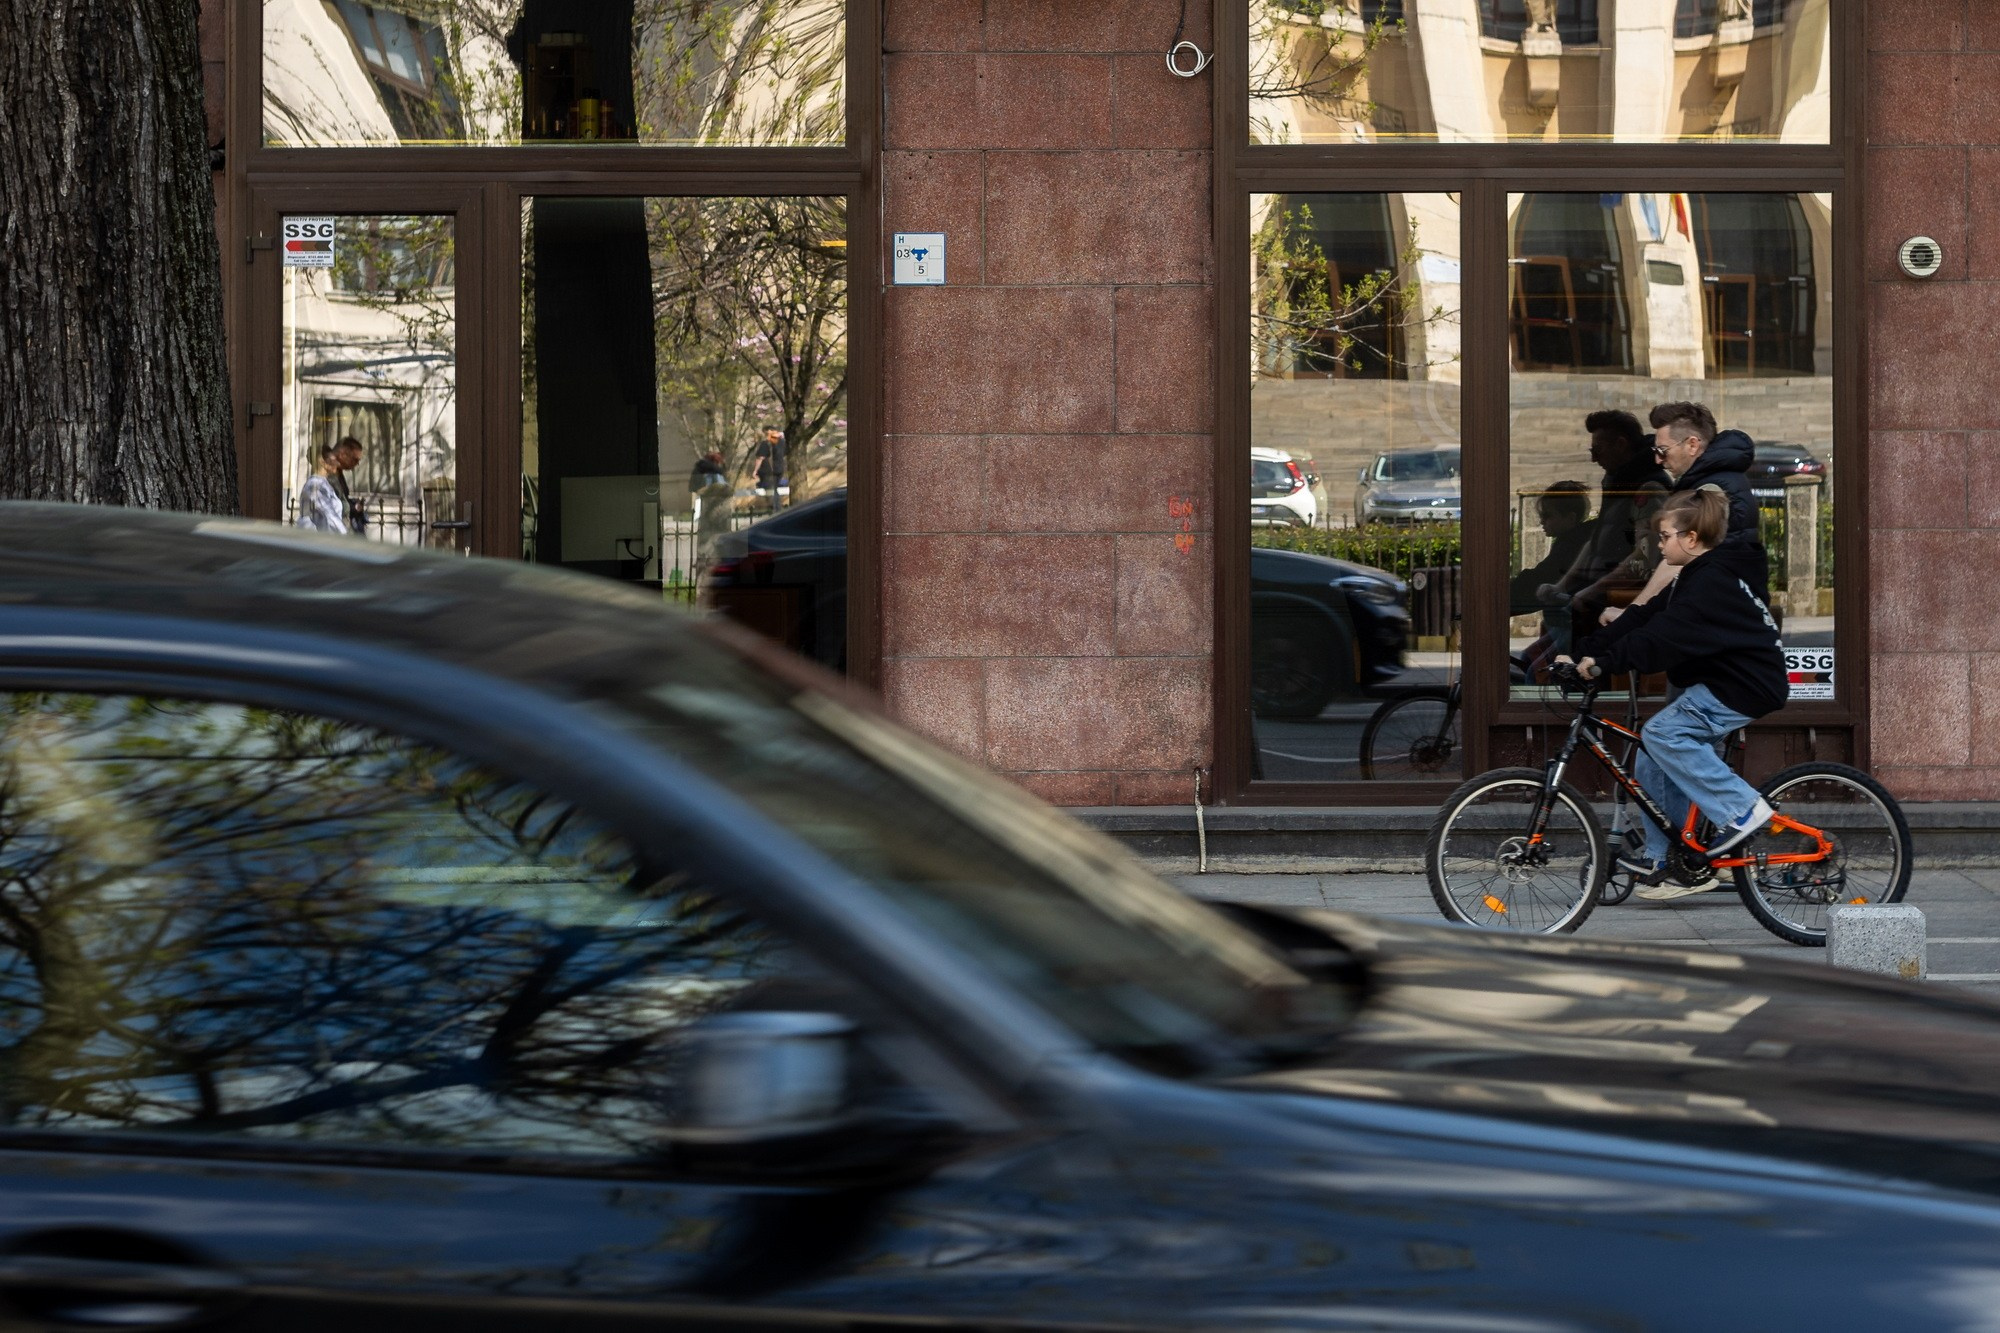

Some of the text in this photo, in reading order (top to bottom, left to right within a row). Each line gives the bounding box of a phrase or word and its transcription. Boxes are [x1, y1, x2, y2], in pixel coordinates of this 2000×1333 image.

[285, 224, 333, 238] SSG
[896, 249, 910, 258] 03
[918, 265, 925, 274] 5
[1785, 655, 1833, 670] SSG
